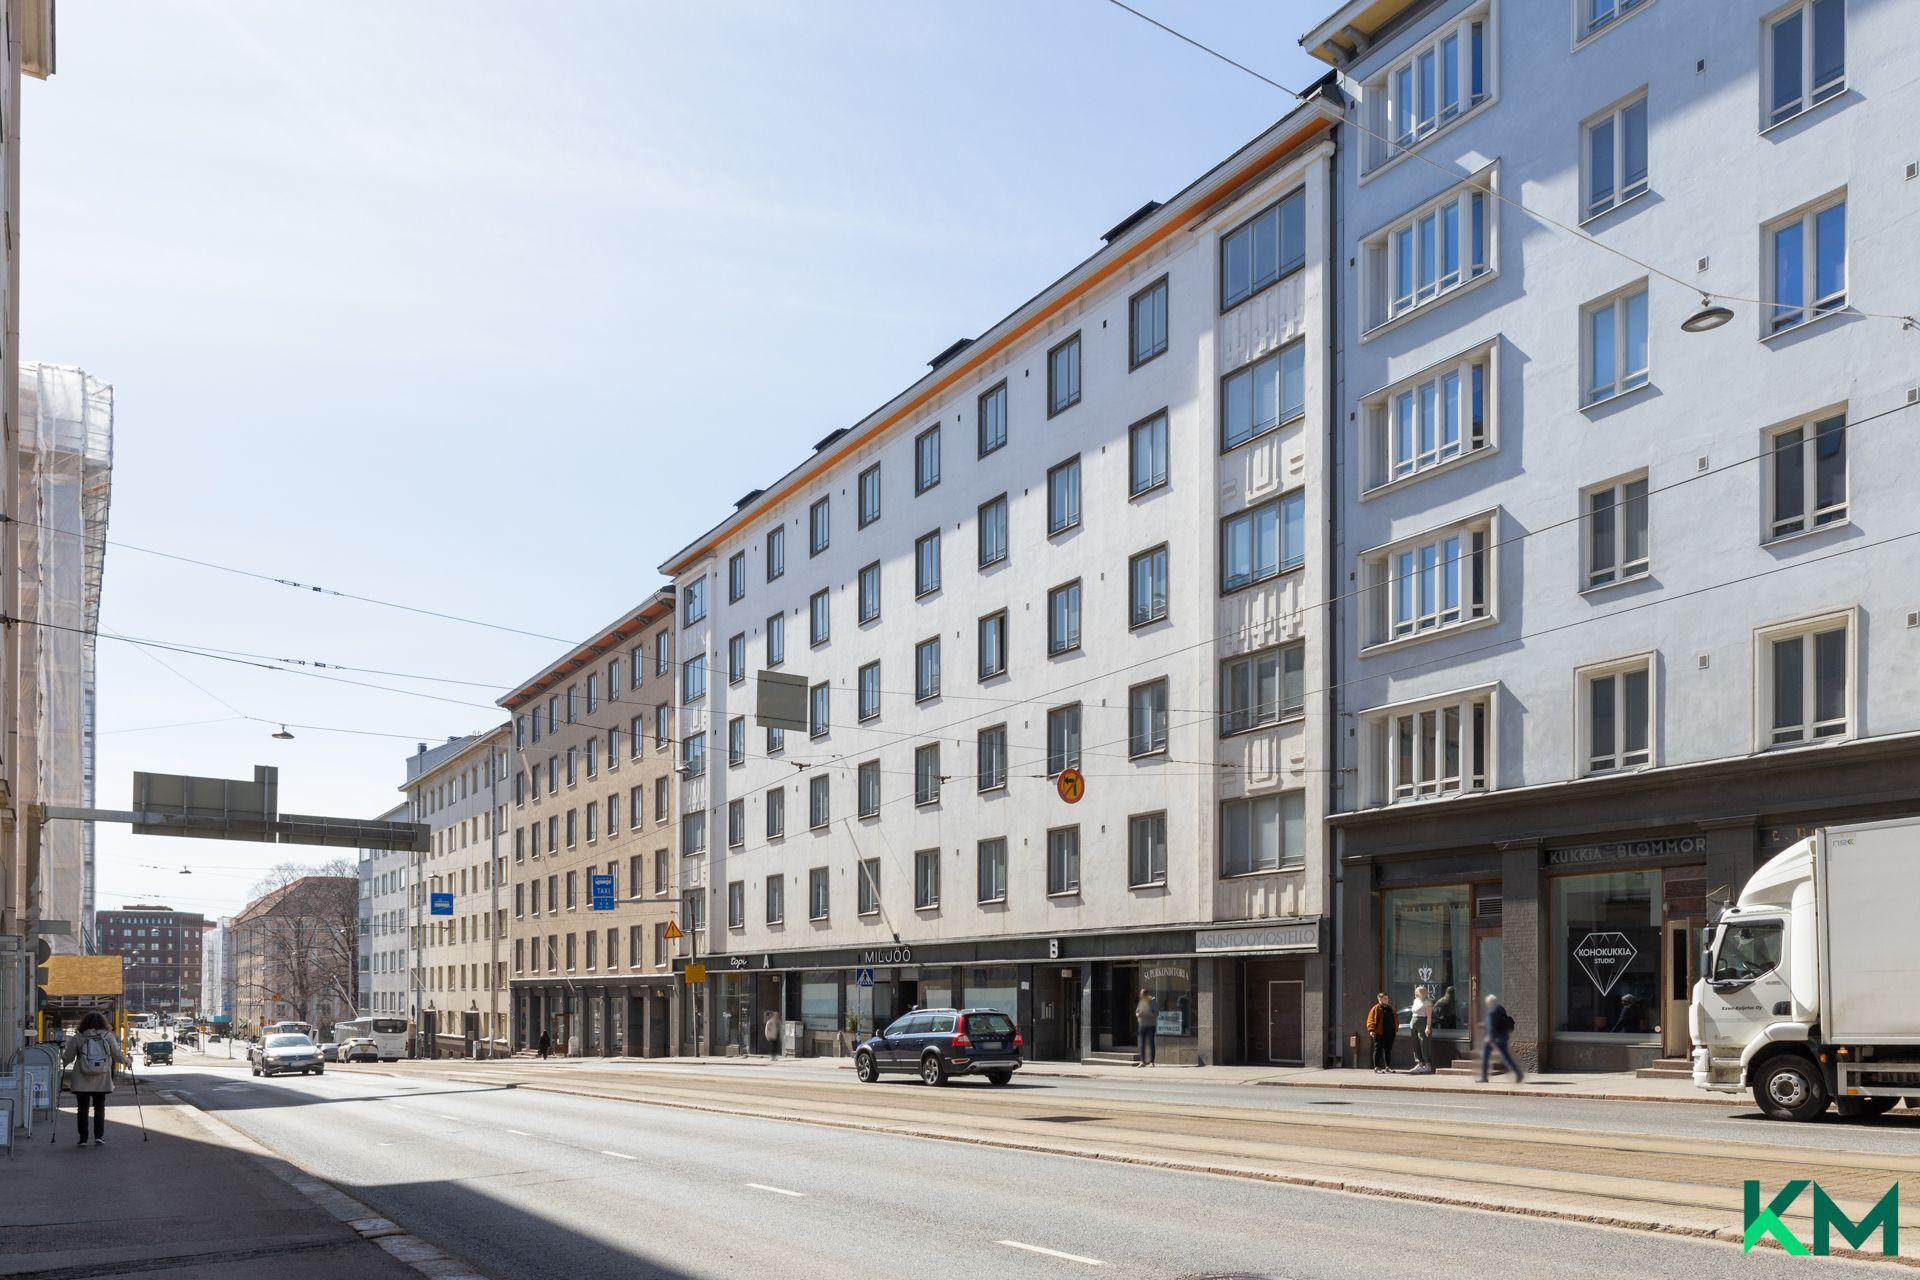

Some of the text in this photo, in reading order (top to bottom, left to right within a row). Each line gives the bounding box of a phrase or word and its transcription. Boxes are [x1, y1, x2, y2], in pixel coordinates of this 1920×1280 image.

[1550, 838, 1706, 864] KUKKIA BLOMMOR
[597, 887, 611, 895] TAXI
[1199, 929, 1315, 948] ASUNTO OY OSTELLO
[865, 946, 911, 963] MILJÖÖ
[1049, 939, 1060, 959] B
[1578, 947, 1632, 957] KOHOKUKKIA
[730, 956, 748, 969] topi
[763, 954, 770, 969] A
